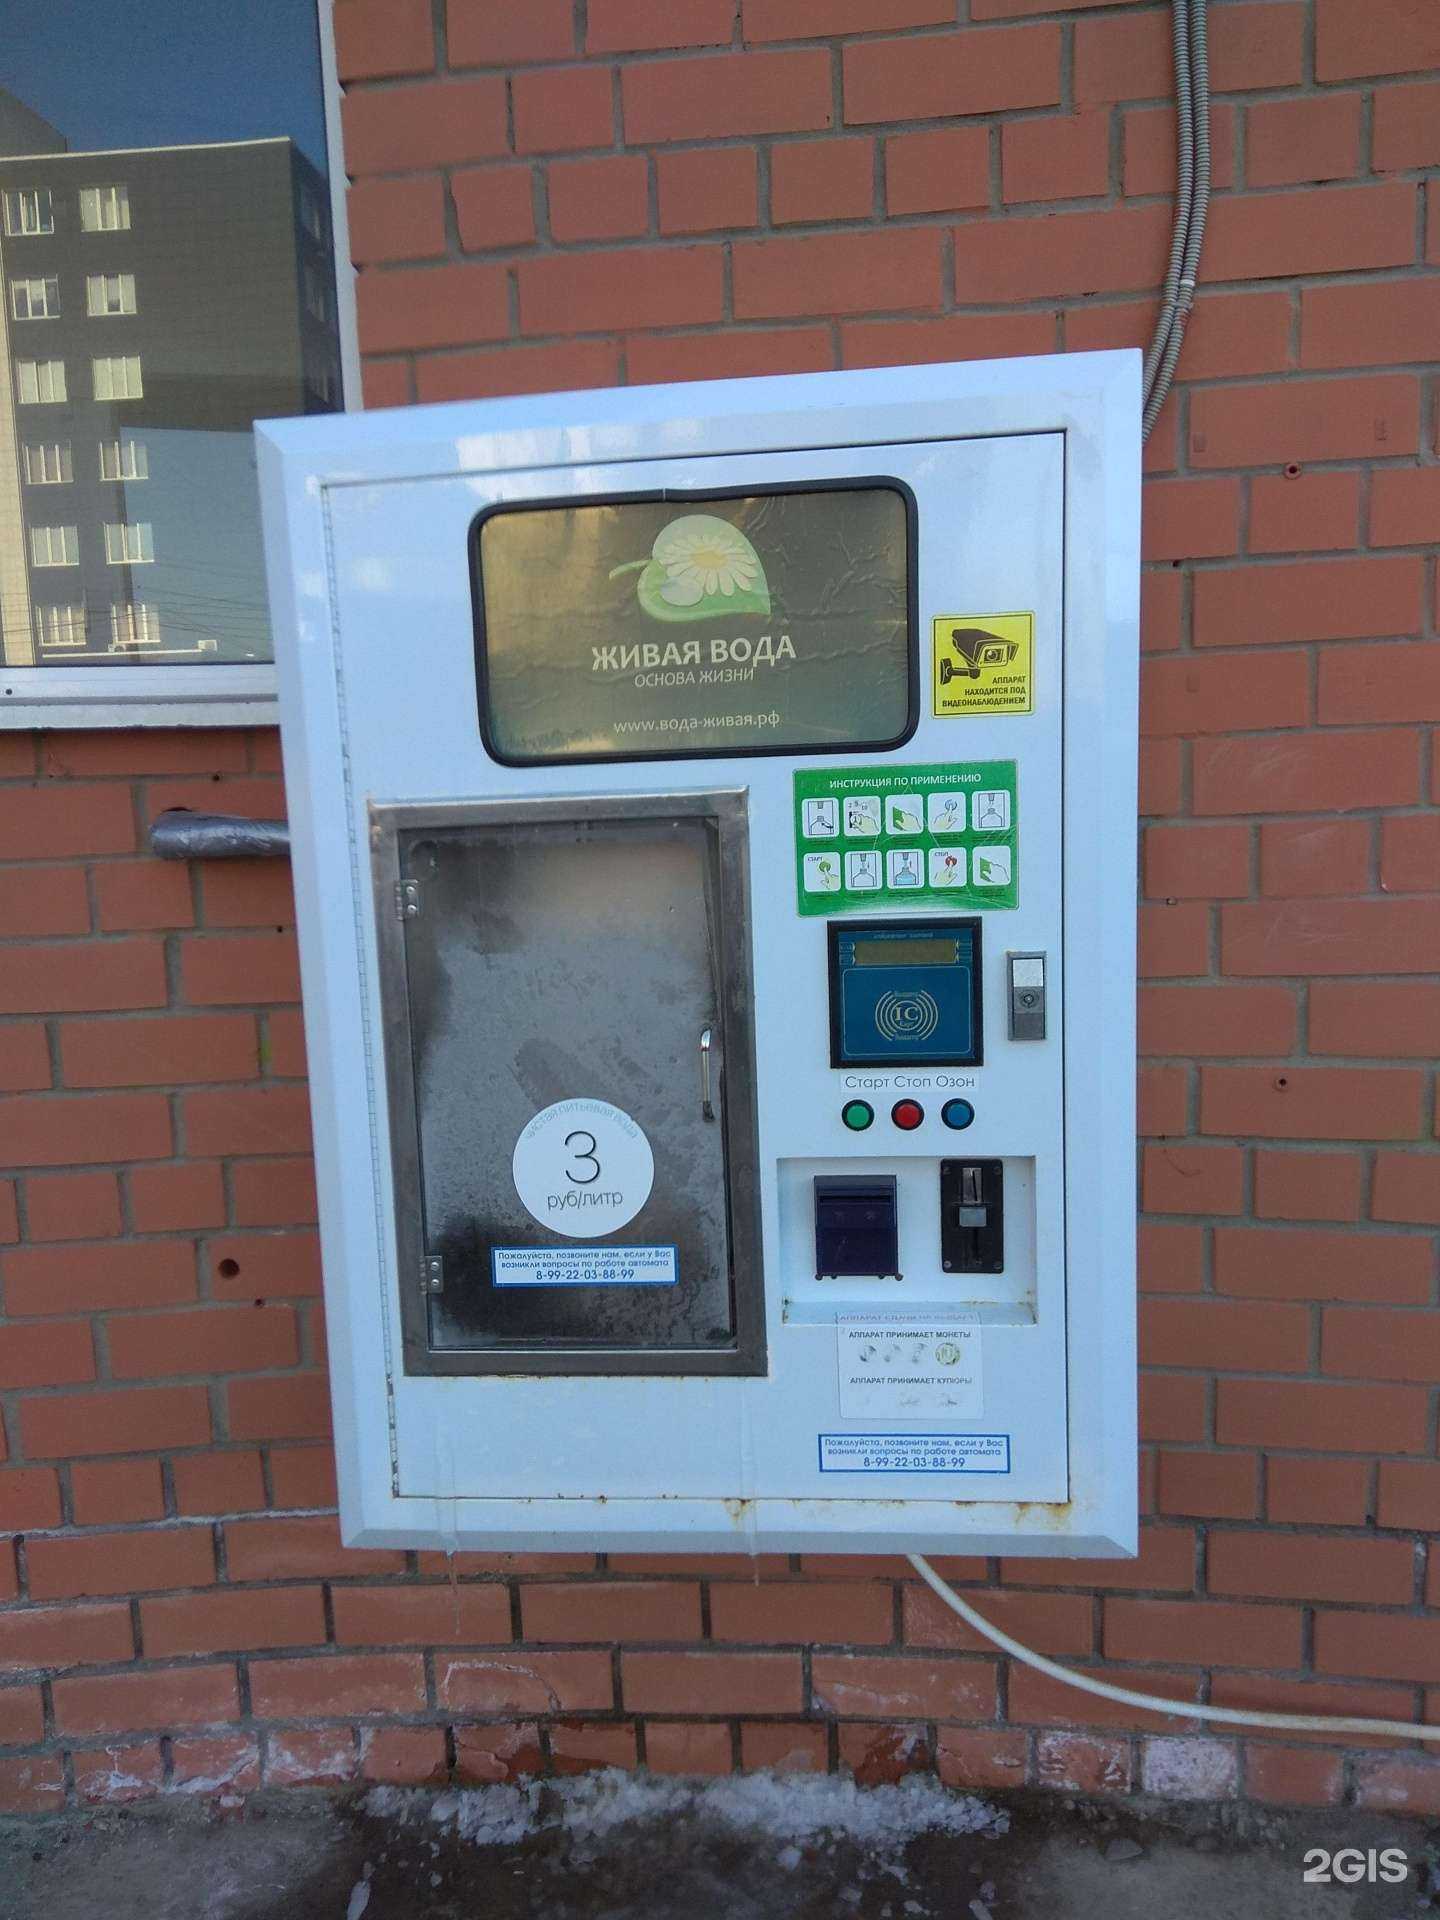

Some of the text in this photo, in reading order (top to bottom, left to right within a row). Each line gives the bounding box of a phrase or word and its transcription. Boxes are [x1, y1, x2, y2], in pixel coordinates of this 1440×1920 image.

[592, 635, 797, 672] ЖИВАЯ ВОДА
[634, 667, 755, 688] ОСНОВА ЖИЗНИ
[992, 675, 1026, 685] АППАРАТ
[964, 685, 1027, 697] НАХОДИТСЯ ПОД
[942, 696, 1026, 709] ВИДЕОНАБЛЮДЕНИЕМ
[613, 710, 780, 735] www.вода-живая.рф
[829, 773, 982, 789] ИНСТРУКЦИЯ ПО ПРИМЕНЕНИЮ
[845, 1075, 975, 1090] Старт Стоп Озон
[564, 1130, 600, 1184] 3
[547, 1190, 623, 1211] руб/литр
[556, 1251, 599, 1260] позвоните
[624, 1250, 645, 1258] если
[655, 1250, 671, 1258] Вас
[501, 1261, 541, 1269] возникли
[542, 1261, 580, 1270] вопросы
[594, 1259, 626, 1269] работе
[628, 1259, 669, 1267] автомата
[536, 1269, 635, 1281] 8-99-22-03-88-99
[849, 1331, 971, 1339] АППАРАТ ПРИНИМАЕТ МОНЕТЫ
[850, 1377, 886, 1385] АППАРАТ
[887, 1377, 935, 1385] ПРИНИМАЕТ
[884, 1439, 929, 1447] позвоните
[954, 1439, 977, 1447] если
[986, 1438, 1003, 1447] Вас
[828, 1447, 1001, 1457] возникли вопросы по работе автомата
[863, 1457, 966, 1468] 8-99-22-03-88-99
